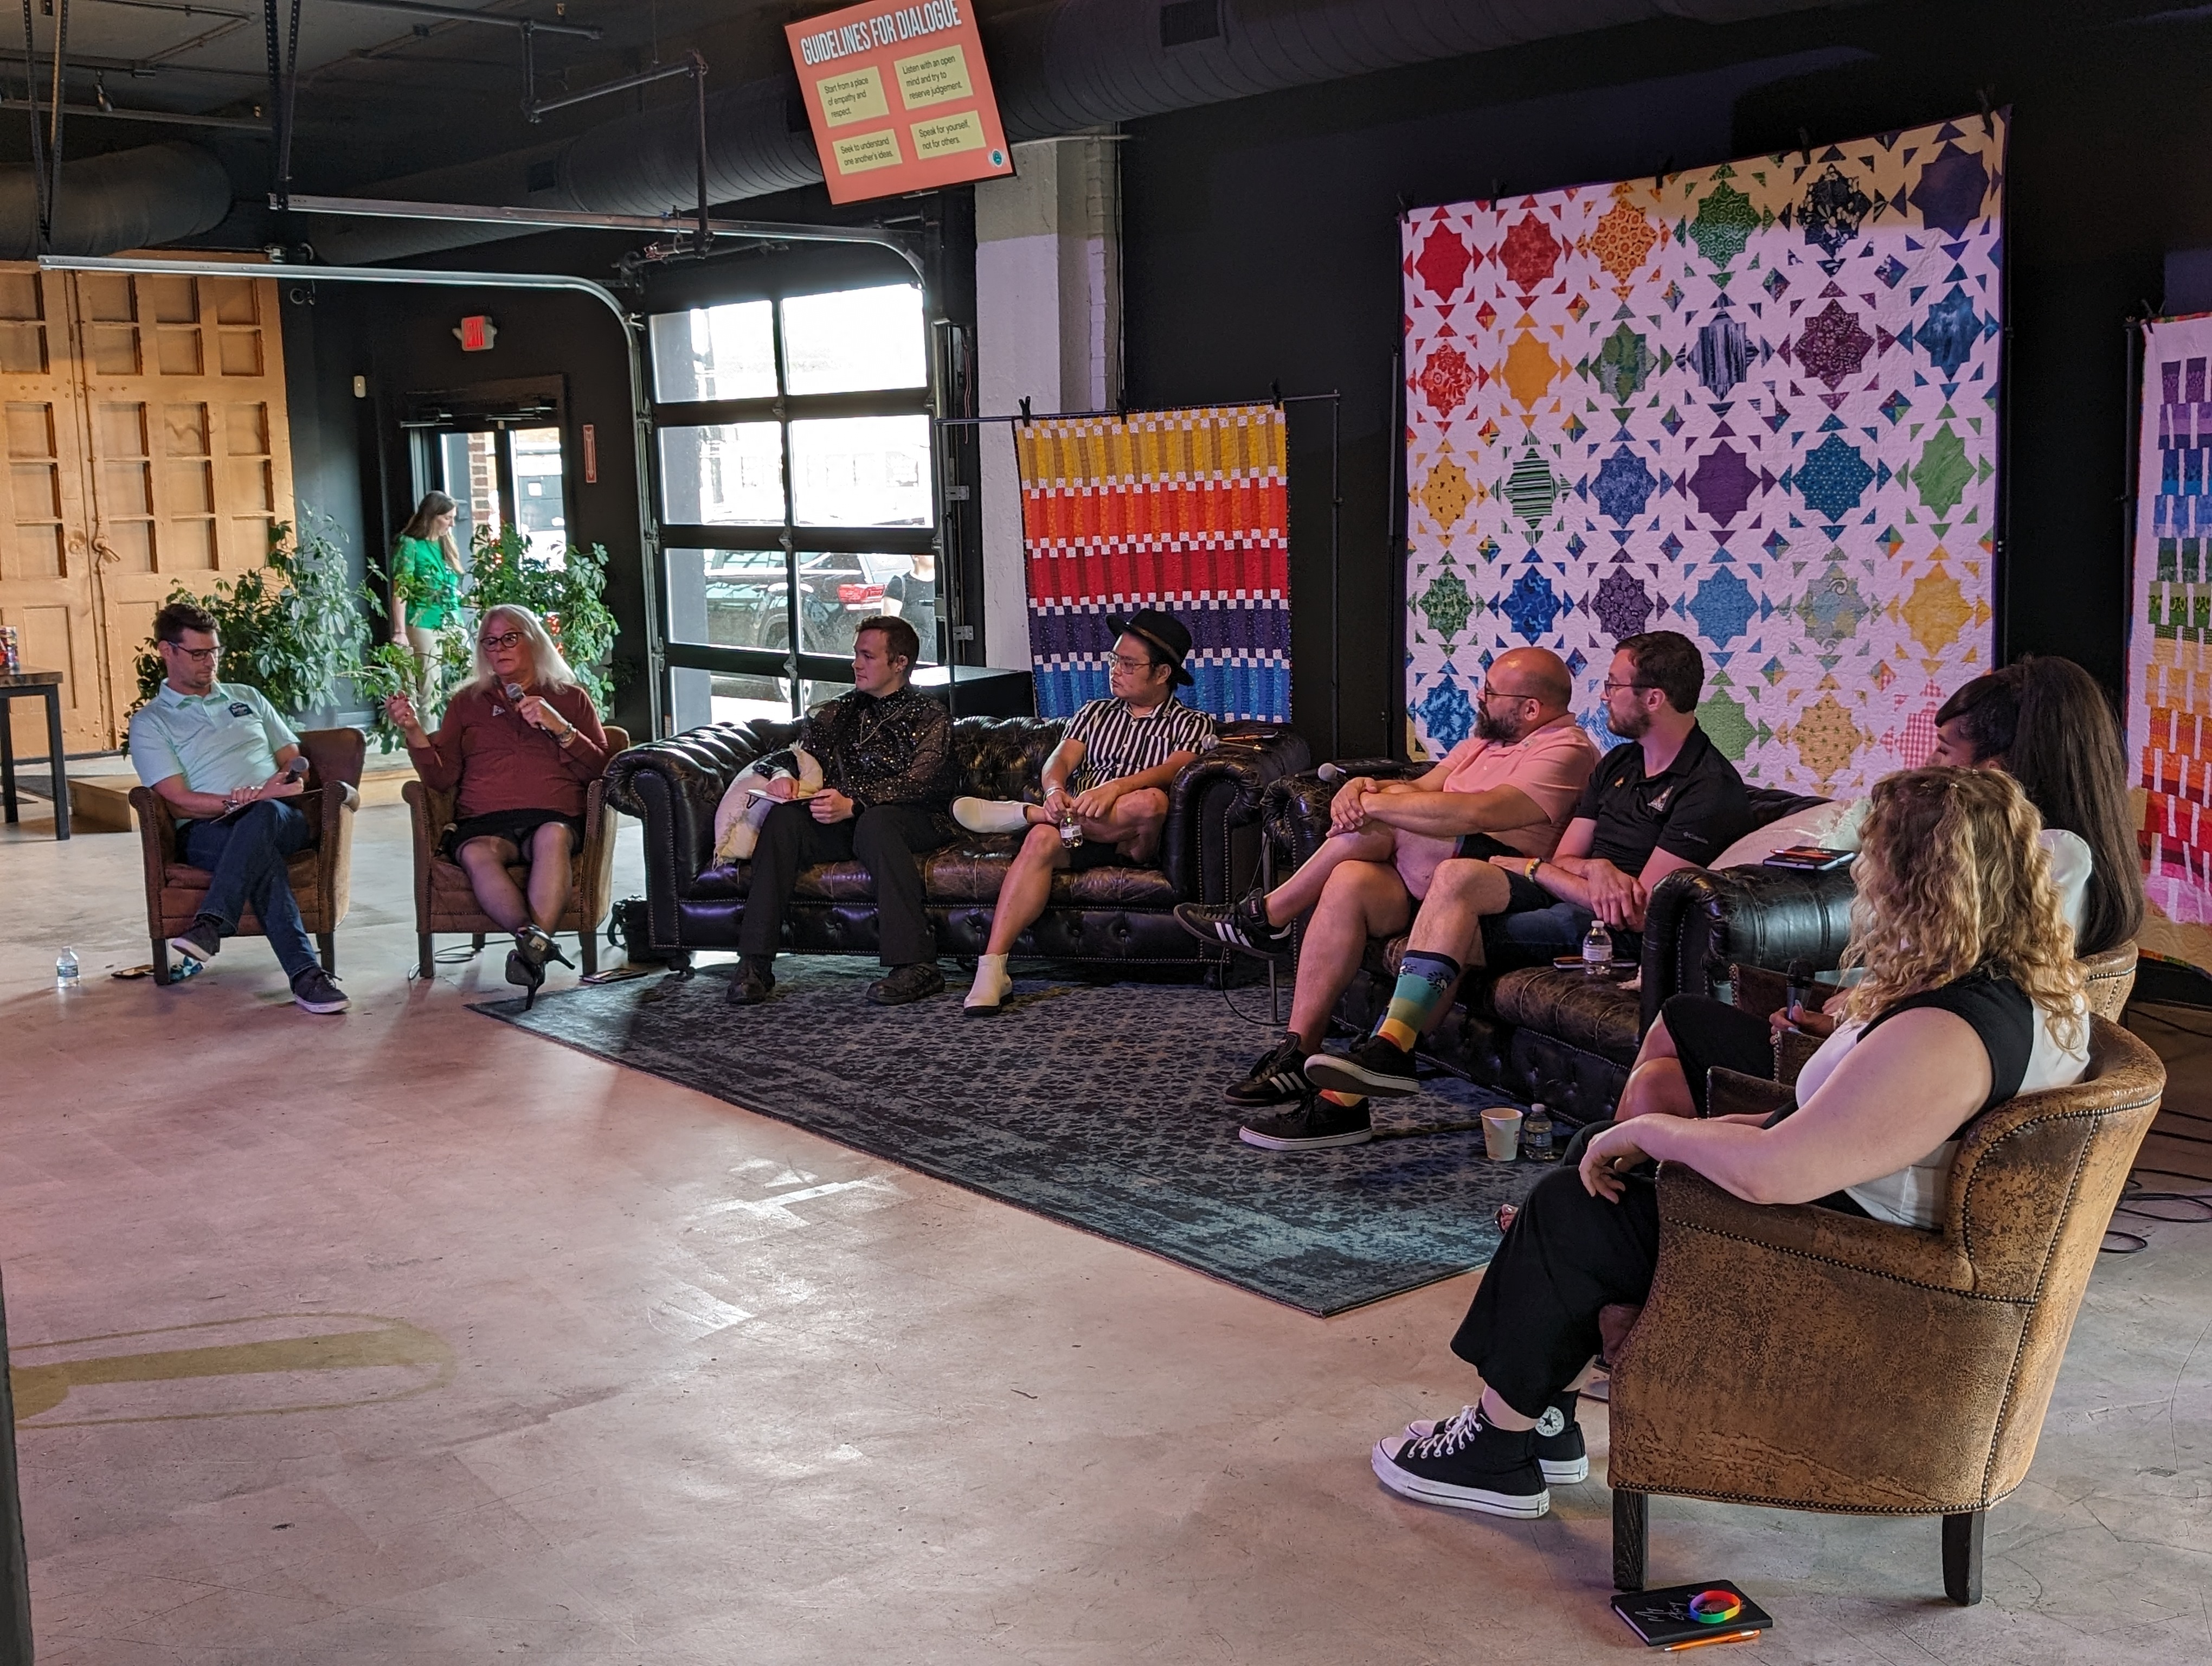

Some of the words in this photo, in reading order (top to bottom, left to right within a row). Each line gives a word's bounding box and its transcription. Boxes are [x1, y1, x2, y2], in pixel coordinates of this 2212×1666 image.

[800, 21, 872, 66] GUIDELINES
[869, 14, 898, 47] FOR
[895, 0, 962, 41] DIALOGUE
[902, 64, 920, 75] Listen
[920, 60, 933, 71] with
[933, 60, 941, 68] an
[940, 55, 956, 67] open
[824, 85, 838, 94] Start
[837, 82, 850, 91] from
[854, 77, 869, 89] place
[906, 76, 921, 87] mind
[921, 73, 931, 84] and
[931, 73, 940, 82] try
[940, 71, 947, 79] to
[827, 97, 833, 106] of
[834, 93, 856, 105] empathy
[856, 89, 867, 99] and
[909, 88, 931, 100] reserve
[930, 80, 963, 97] judgement.
[831, 107, 852, 118] respect.
[918, 126, 937, 139] Speak
[936, 125, 945, 134] for
[945, 119, 970, 134] yourself,
[840, 144, 854, 155] Seek
[853, 143, 860, 151] to
[860, 136, 890, 150] understand
[922, 141, 932, 151] not
[931, 139, 941, 149] for
[941, 137, 961, 147] others.
[844, 158, 854, 166] one
[854, 152, 878, 164] another's
[878, 150, 894, 159] ideas.
